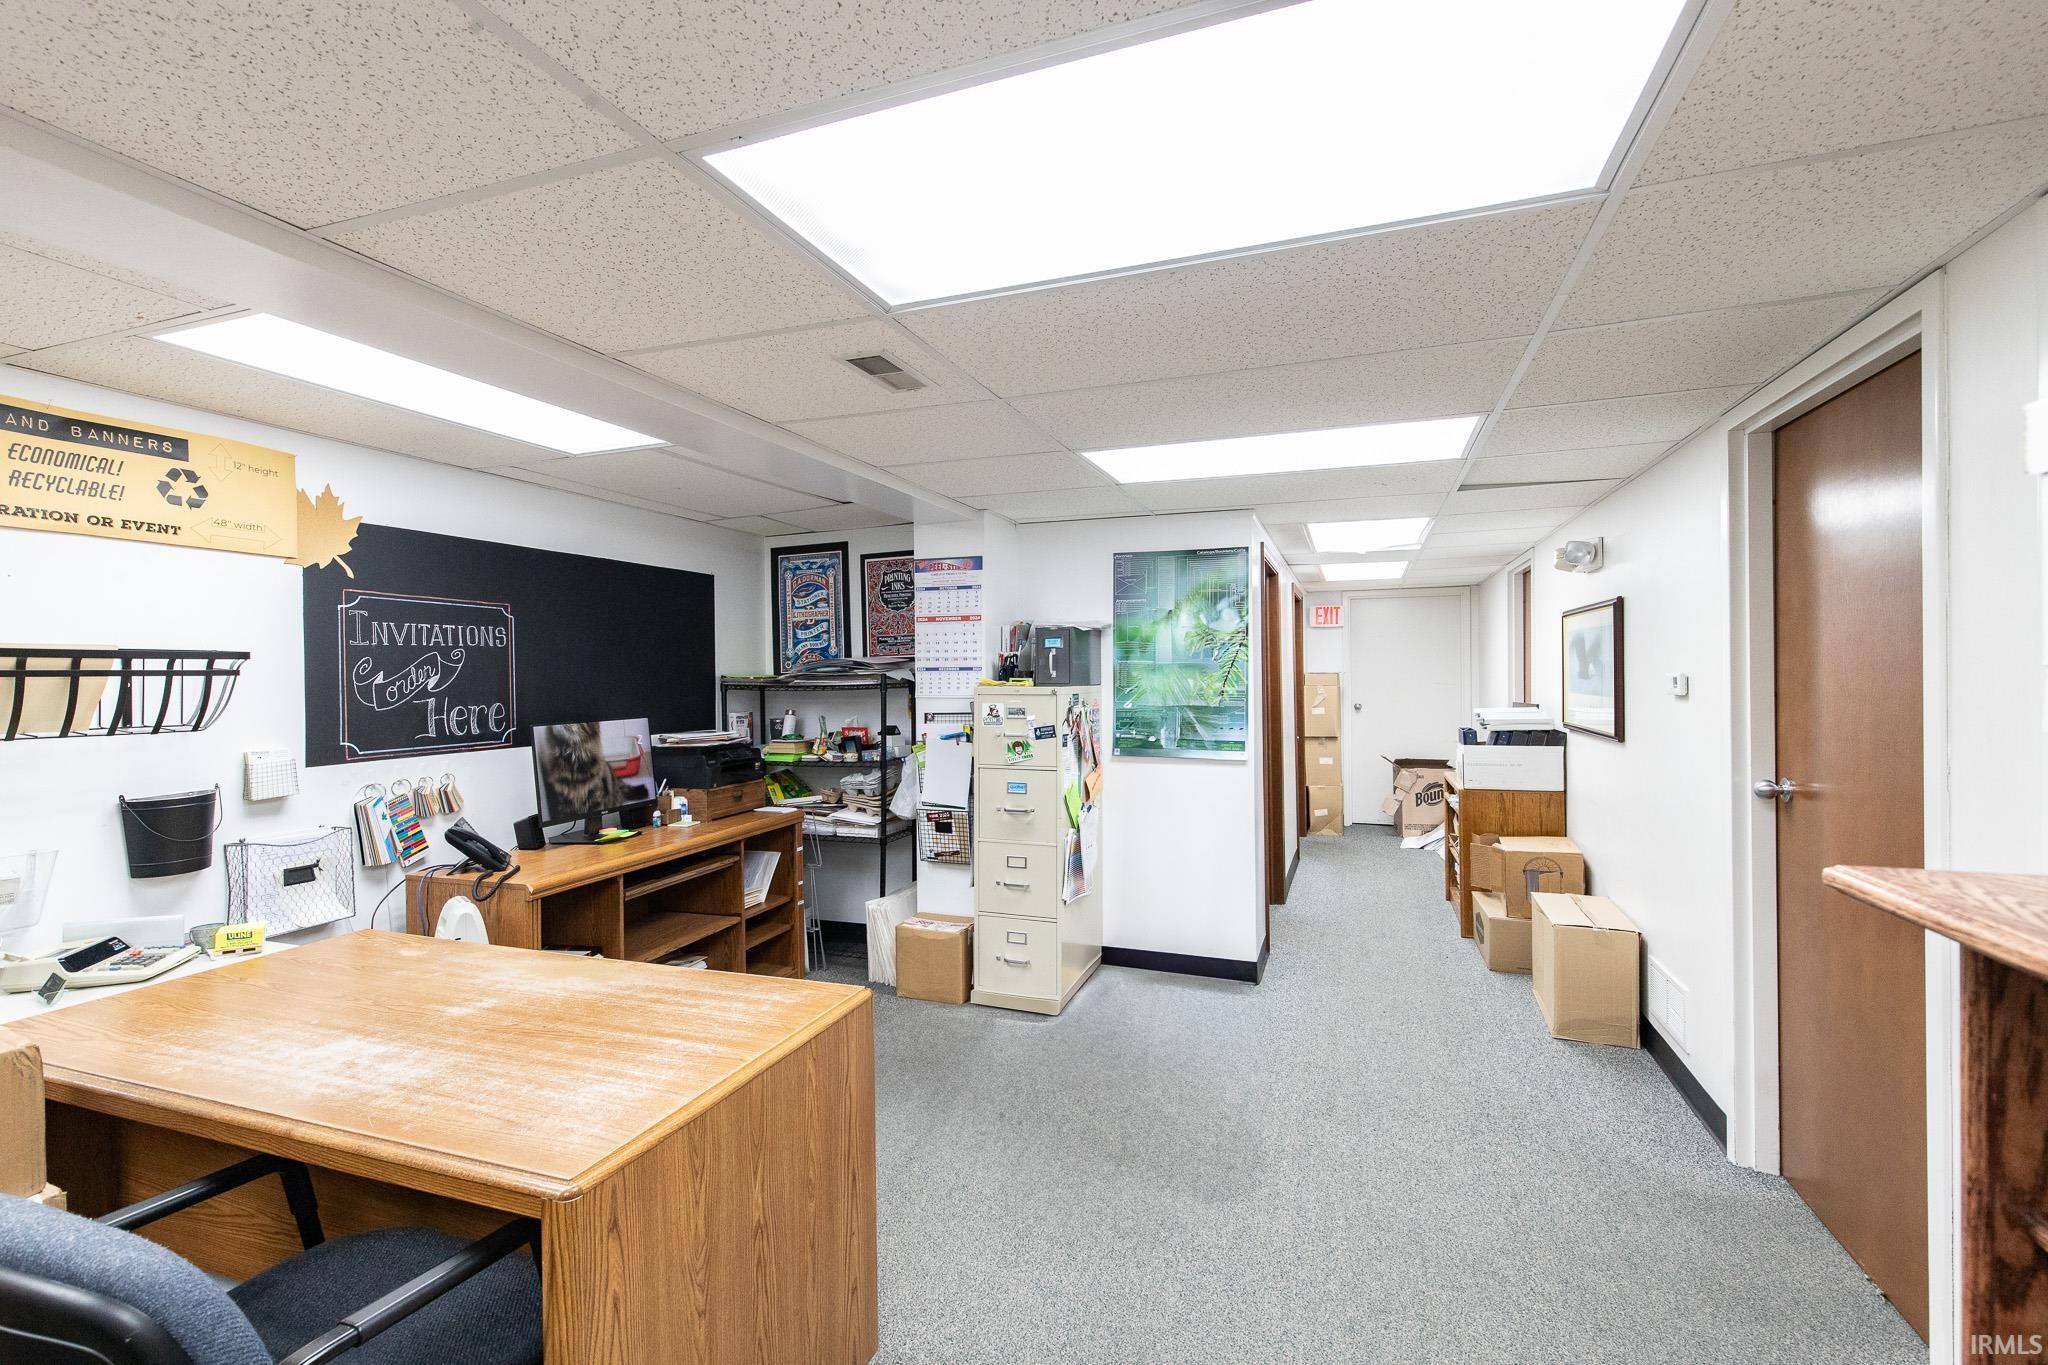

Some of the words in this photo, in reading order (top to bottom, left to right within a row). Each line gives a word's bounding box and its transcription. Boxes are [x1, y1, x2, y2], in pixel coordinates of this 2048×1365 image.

[4, 412, 49, 431] AND
[71, 426, 173, 453] BANNERS
[8, 442, 124, 476] ECONOMICAL!
[248, 464, 279, 478] height
[8, 469, 125, 501] RECYCLABLE!
[87, 515, 114, 528] OR
[121, 519, 181, 536] EVENT
[234, 522, 263, 531] width
[884, 572, 911, 584] PRINTING
[891, 582, 906, 591] INKS
[1315, 606, 1341, 625] EXIT
[349, 610, 507, 648] INVITATIONS
[386, 664, 436, 702] order
[413, 697, 506, 739] Here
